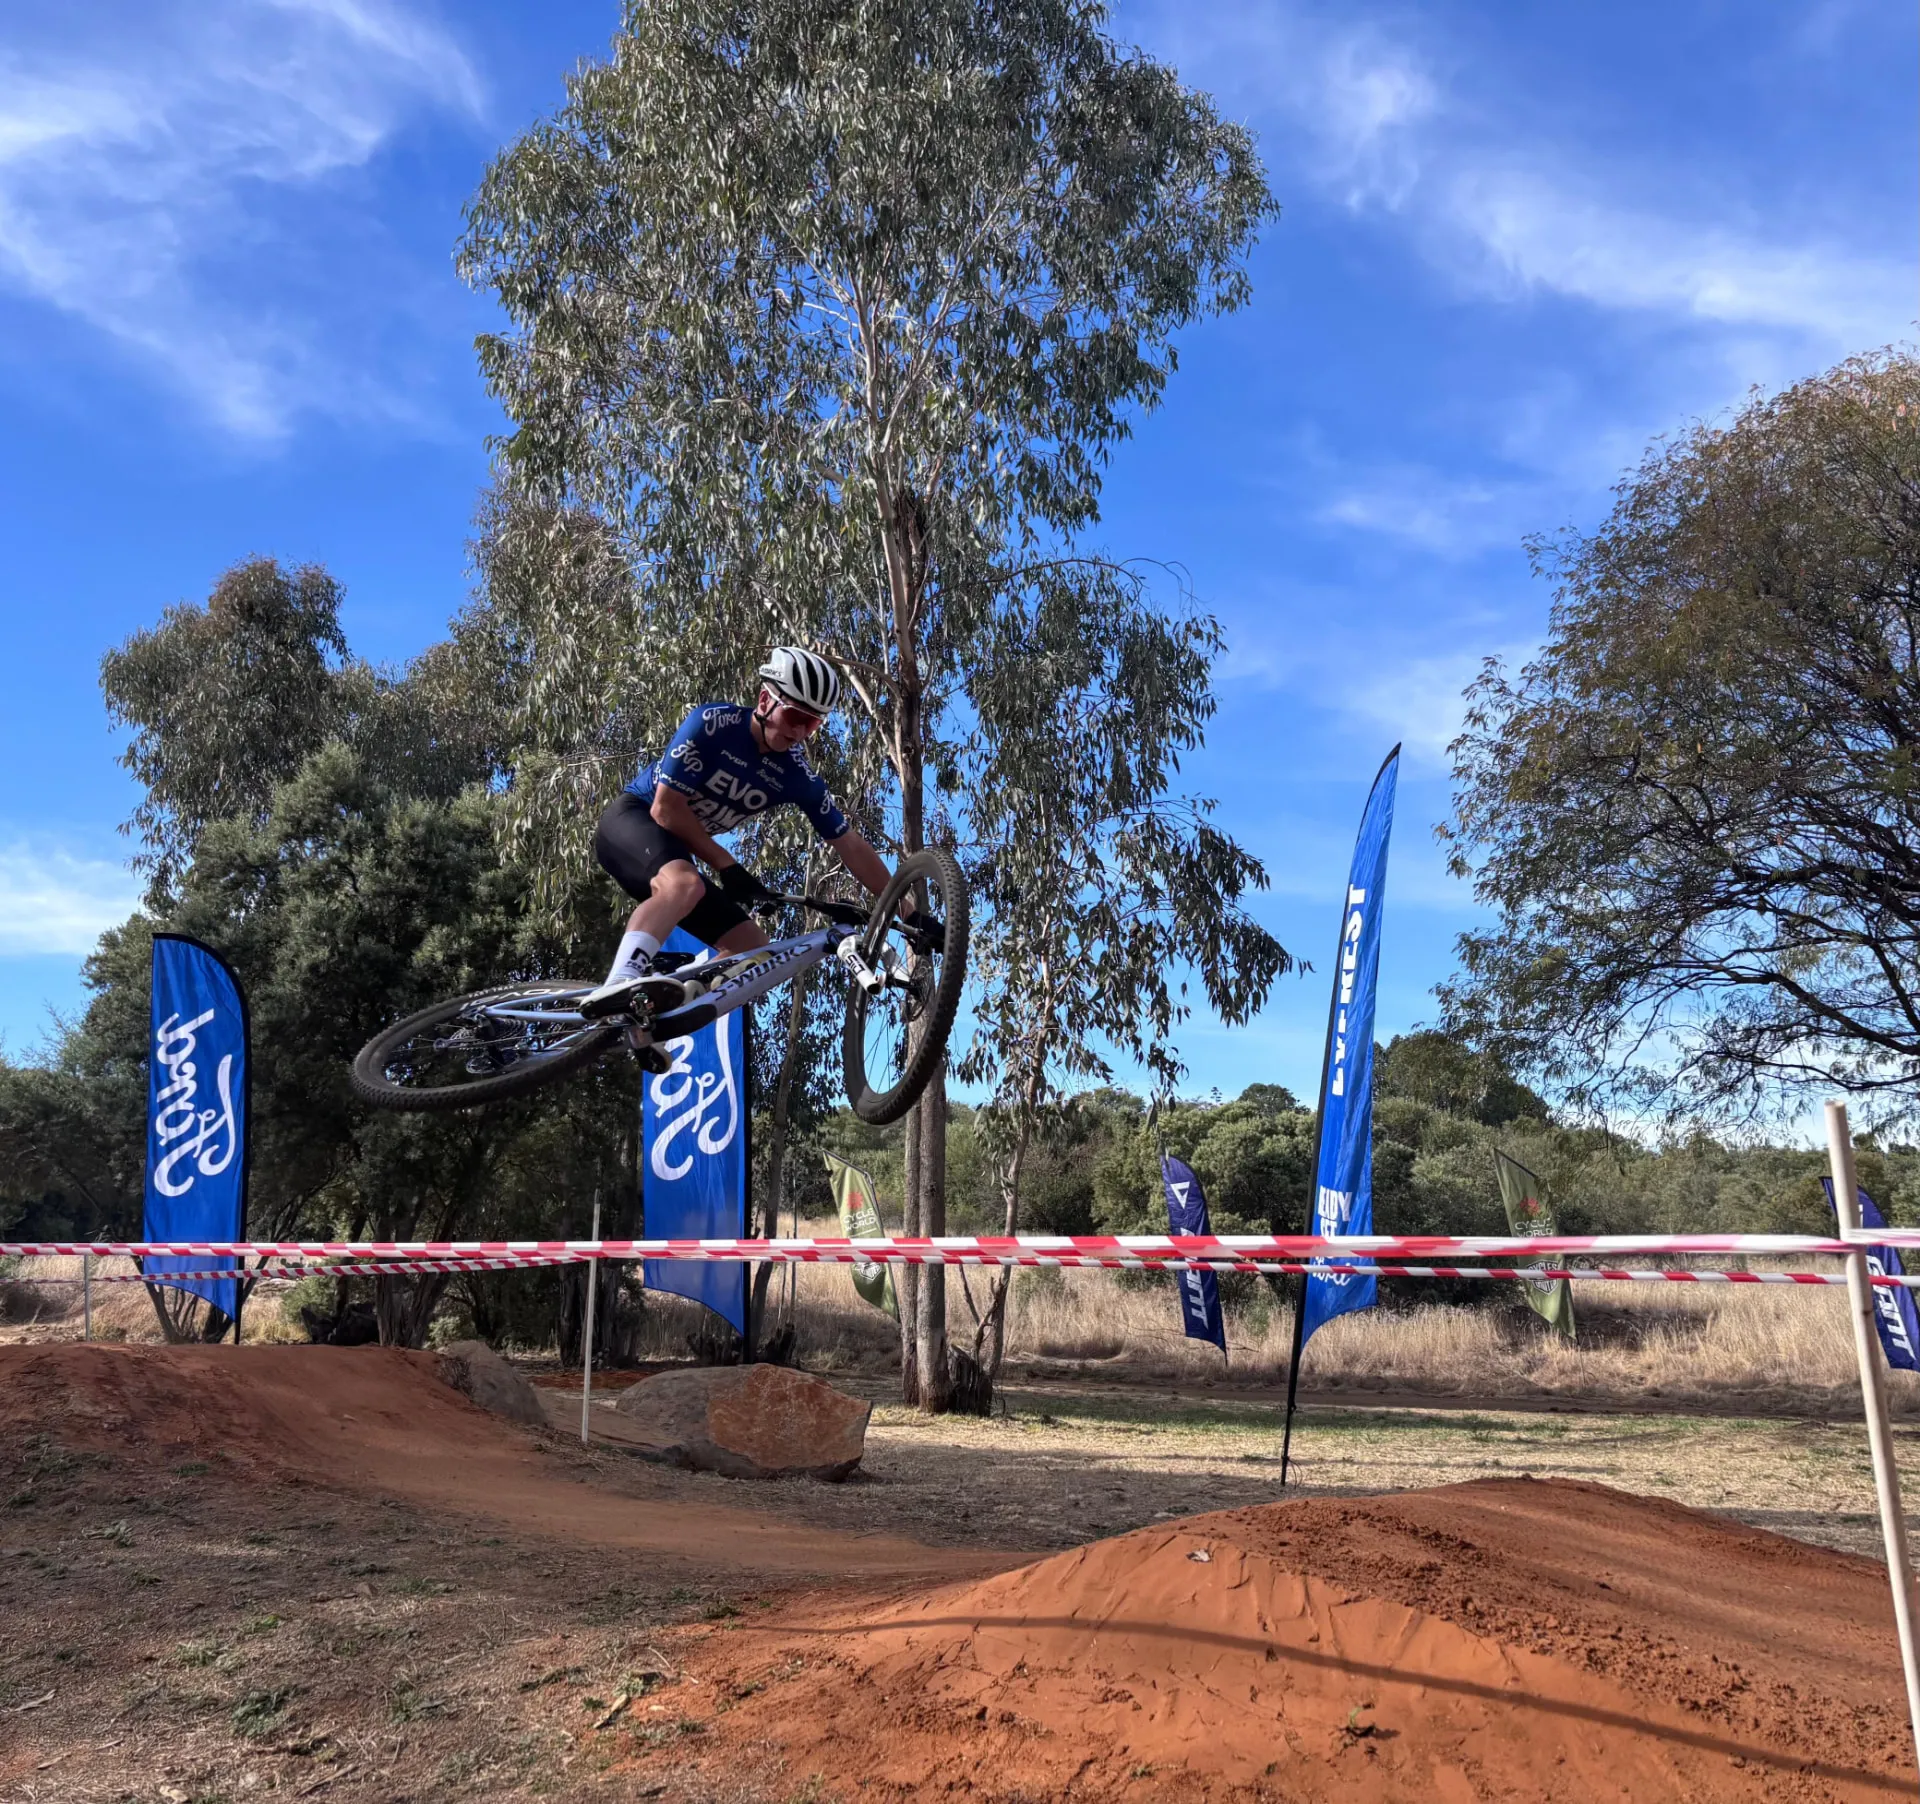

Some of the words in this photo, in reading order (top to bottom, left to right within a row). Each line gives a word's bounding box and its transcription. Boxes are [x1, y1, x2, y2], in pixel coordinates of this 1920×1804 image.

[702, 705, 742, 736] Ford
[704, 769, 768, 810] EVO
[711, 943, 812, 1001] S-WORKS
[843, 1207, 875, 1224] CYCLE
[845, 1216, 876, 1232] WORLD
[1517, 1228, 1553, 1238] WORLD
